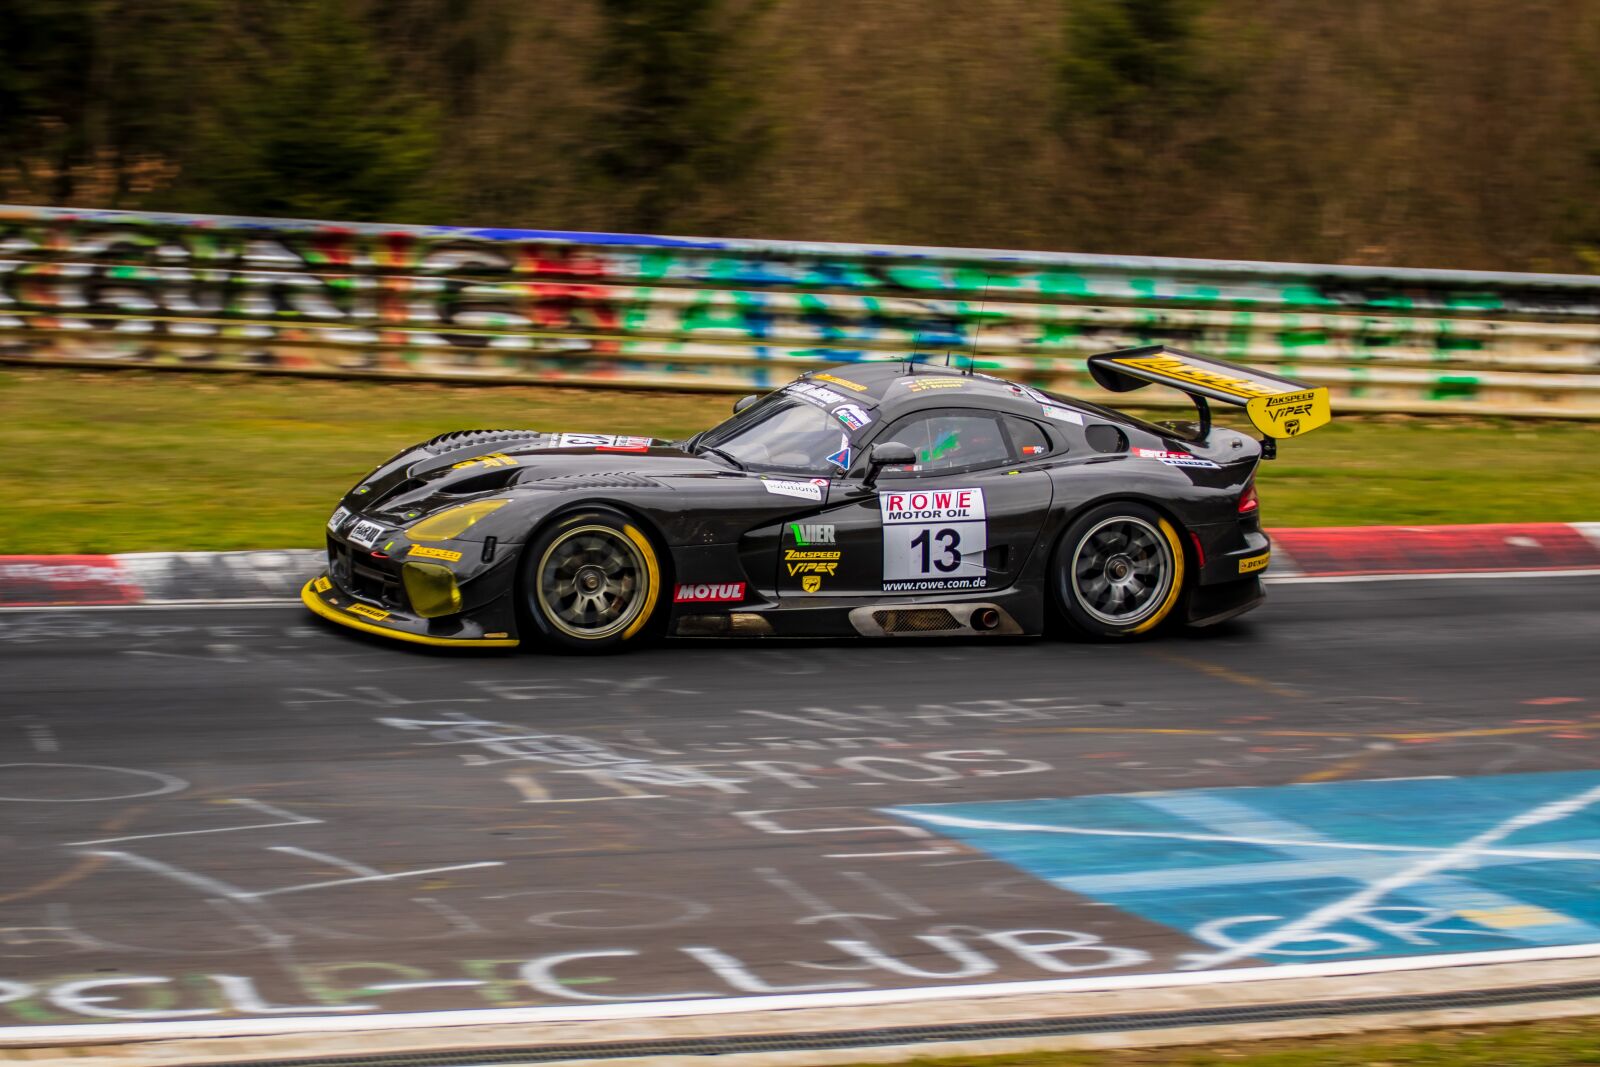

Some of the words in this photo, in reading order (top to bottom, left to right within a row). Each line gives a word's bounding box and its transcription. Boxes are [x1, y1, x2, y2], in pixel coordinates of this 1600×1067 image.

[1265, 392, 1315, 407] ZAKSPEED
[1268, 403, 1313, 422] VIPER
[889, 491, 972, 511] ROWE
[888, 510, 942, 520] MOTOR
[946, 509, 970, 518] OIL
[407, 543, 463, 562] ZAKSPEED
[784, 549, 841, 560] ZAKSPEED
[910, 528, 962, 573] 13
[786, 562, 839, 577] VIPER
[676, 583, 742, 600] MOTUL
[882, 577, 987, 591] www.rowe.com.de
